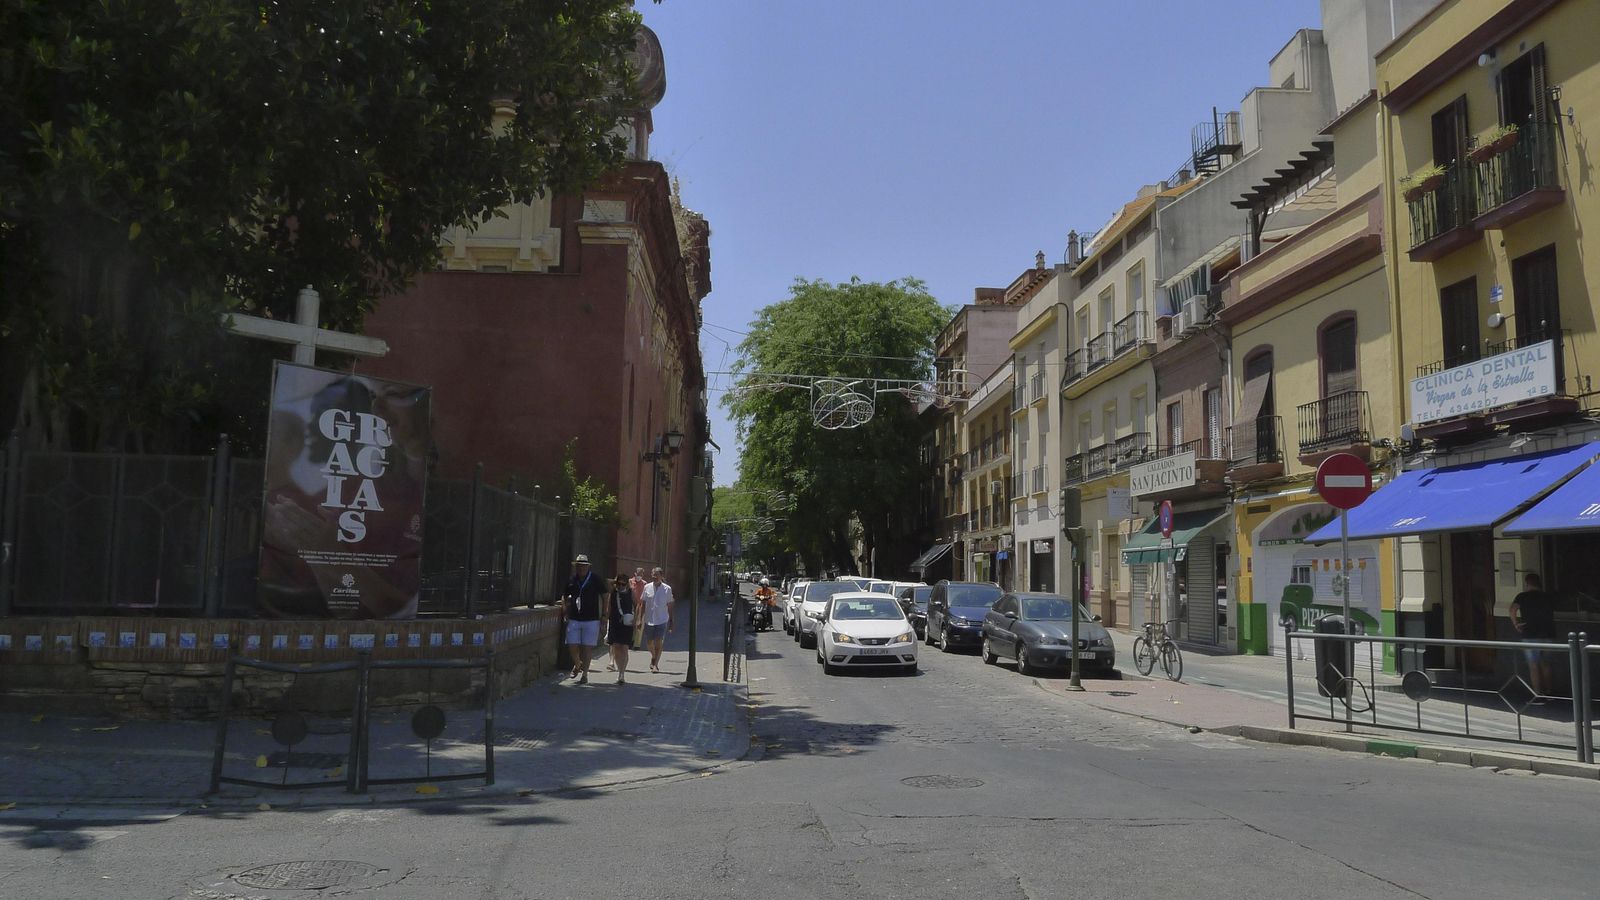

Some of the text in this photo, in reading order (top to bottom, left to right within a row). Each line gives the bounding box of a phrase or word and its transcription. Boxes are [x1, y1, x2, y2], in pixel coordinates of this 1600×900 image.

[1416, 348, 1547, 393] CLINICA DENTAL
[1426, 366, 1535, 408] Virgen de la Estrella
[1540, 385, 1549, 394] B
[1417, 396, 1498, 421] TELF. 4344207
[1147, 459, 1175, 473] CALZADOS
